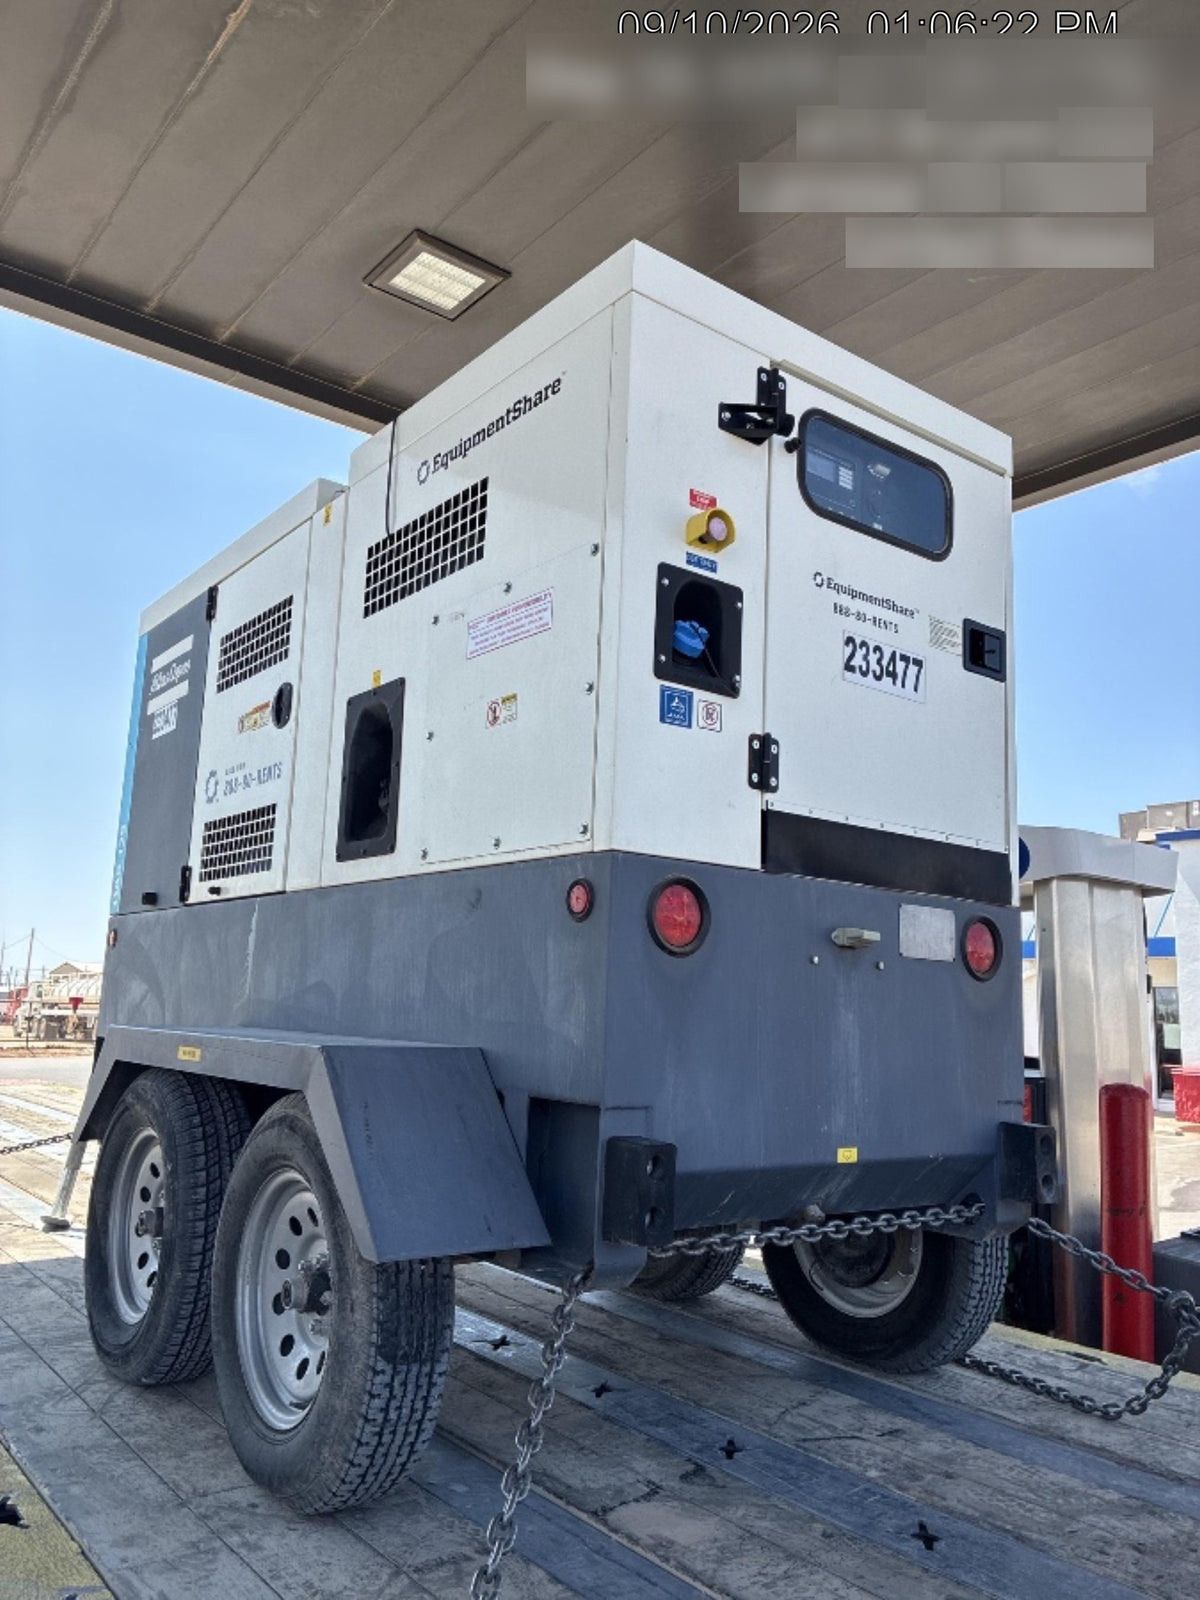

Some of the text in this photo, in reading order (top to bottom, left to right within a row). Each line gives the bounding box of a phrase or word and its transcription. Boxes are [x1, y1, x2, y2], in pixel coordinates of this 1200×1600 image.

[432, 378, 562, 473] EquipmentShare
[826, 576, 915, 619] EquipmentShare
[844, 636, 923, 693] 233477
